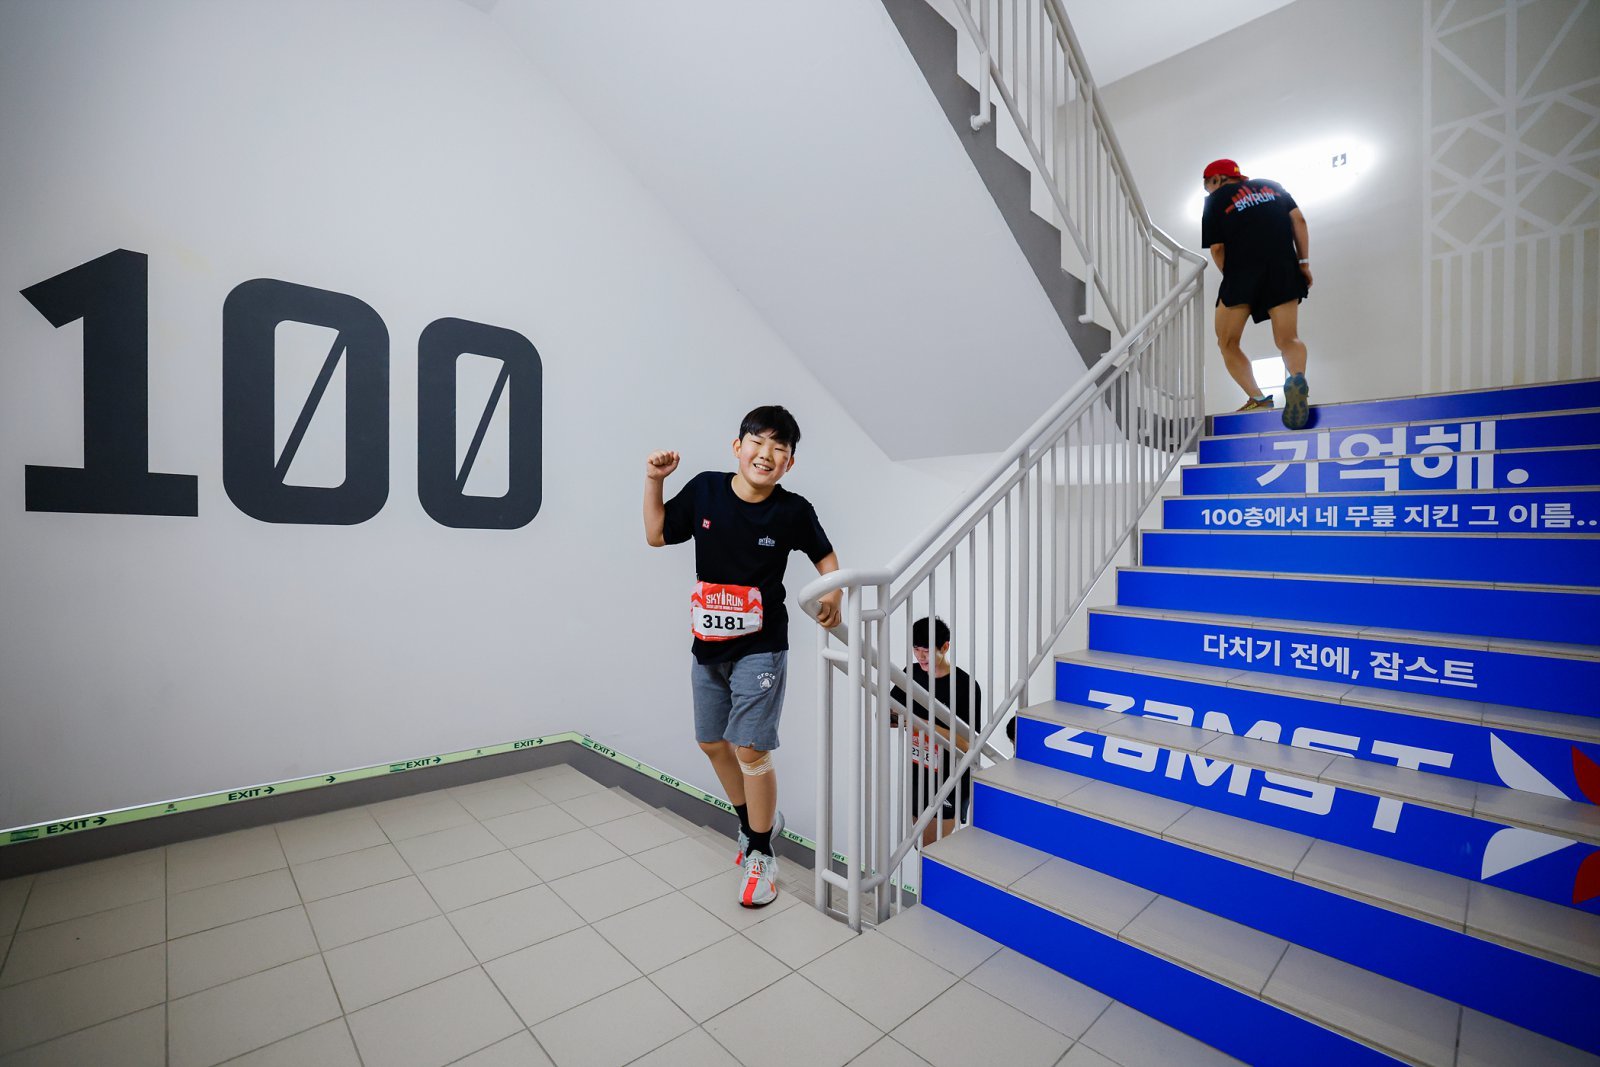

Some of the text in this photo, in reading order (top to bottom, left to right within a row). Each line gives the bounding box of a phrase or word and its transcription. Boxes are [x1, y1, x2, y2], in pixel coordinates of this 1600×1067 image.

[19, 248, 543, 530] 100
[1256, 421, 1529, 494] 기억해.
[1201, 506, 1308, 528] 100층에서
[1315, 505, 1338, 528] 네
[1345, 505, 1397, 528] 무릎
[1404, 504, 1459, 528] 지킨
[1468, 505, 1499, 526] 그
[703, 614, 746, 630] 3181
[1203, 634, 1478, 689] 다치기 전에, 잠스트
[514, 739, 536, 749] EXIT
[593, 743, 610, 755] EXIT
[405, 758, 432, 769] EXIT
[660, 774, 675, 785] EXIT
[228, 788, 262, 801] EXIT
[714, 799, 728, 809] EXIT
[46, 818, 91, 835] EXIT
